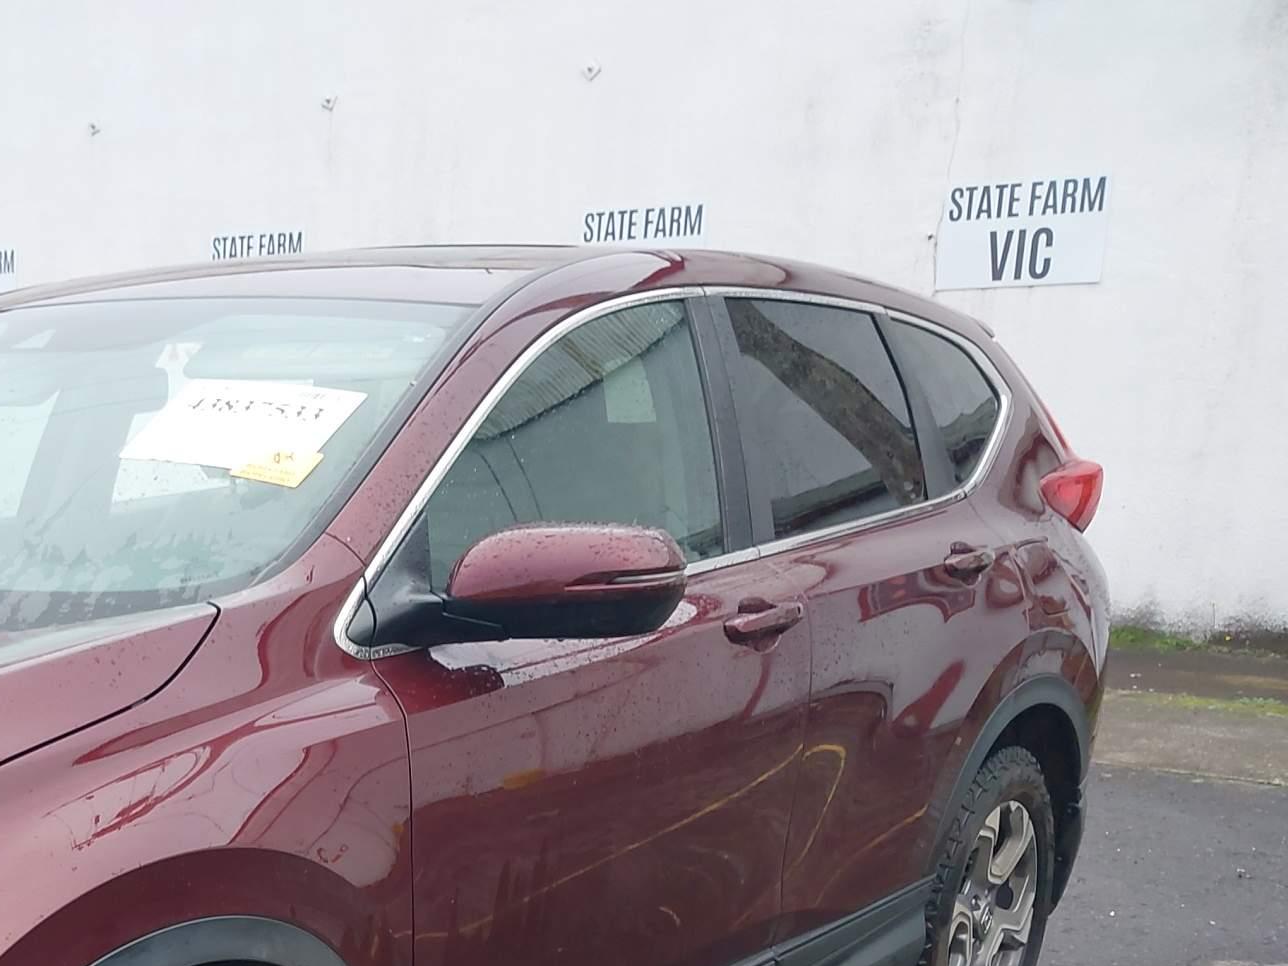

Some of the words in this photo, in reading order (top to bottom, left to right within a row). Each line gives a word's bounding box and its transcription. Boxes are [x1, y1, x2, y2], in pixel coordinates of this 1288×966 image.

[948, 183, 1023, 222] STATE
[1028, 176, 1107, 217] FARM
[259, 231, 302, 257] FARM
[583, 209, 639, 243] STATE
[643, 204, 704, 239] FARM
[989, 227, 1054, 282] VIC
